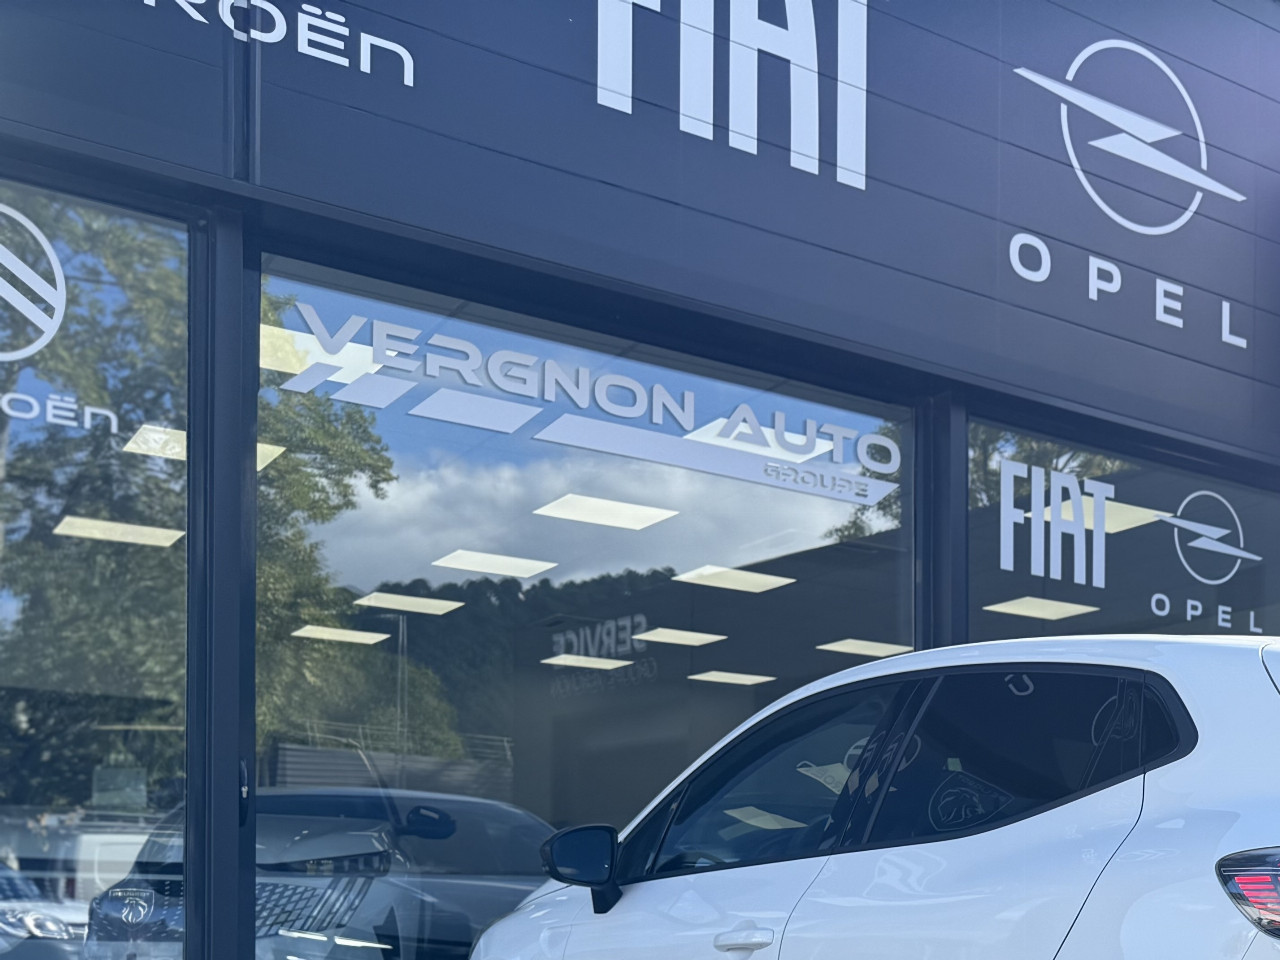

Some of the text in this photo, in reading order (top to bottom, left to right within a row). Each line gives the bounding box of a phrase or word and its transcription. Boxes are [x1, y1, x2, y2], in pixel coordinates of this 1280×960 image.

[1008, 232, 1248, 349] OPEL
[294, 302, 901, 475] VERGNON AUTO
[763, 461, 869, 499] GROUPE
[1000, 458, 1115, 589] FIAT
[1150, 593, 1263, 634] OPEL
